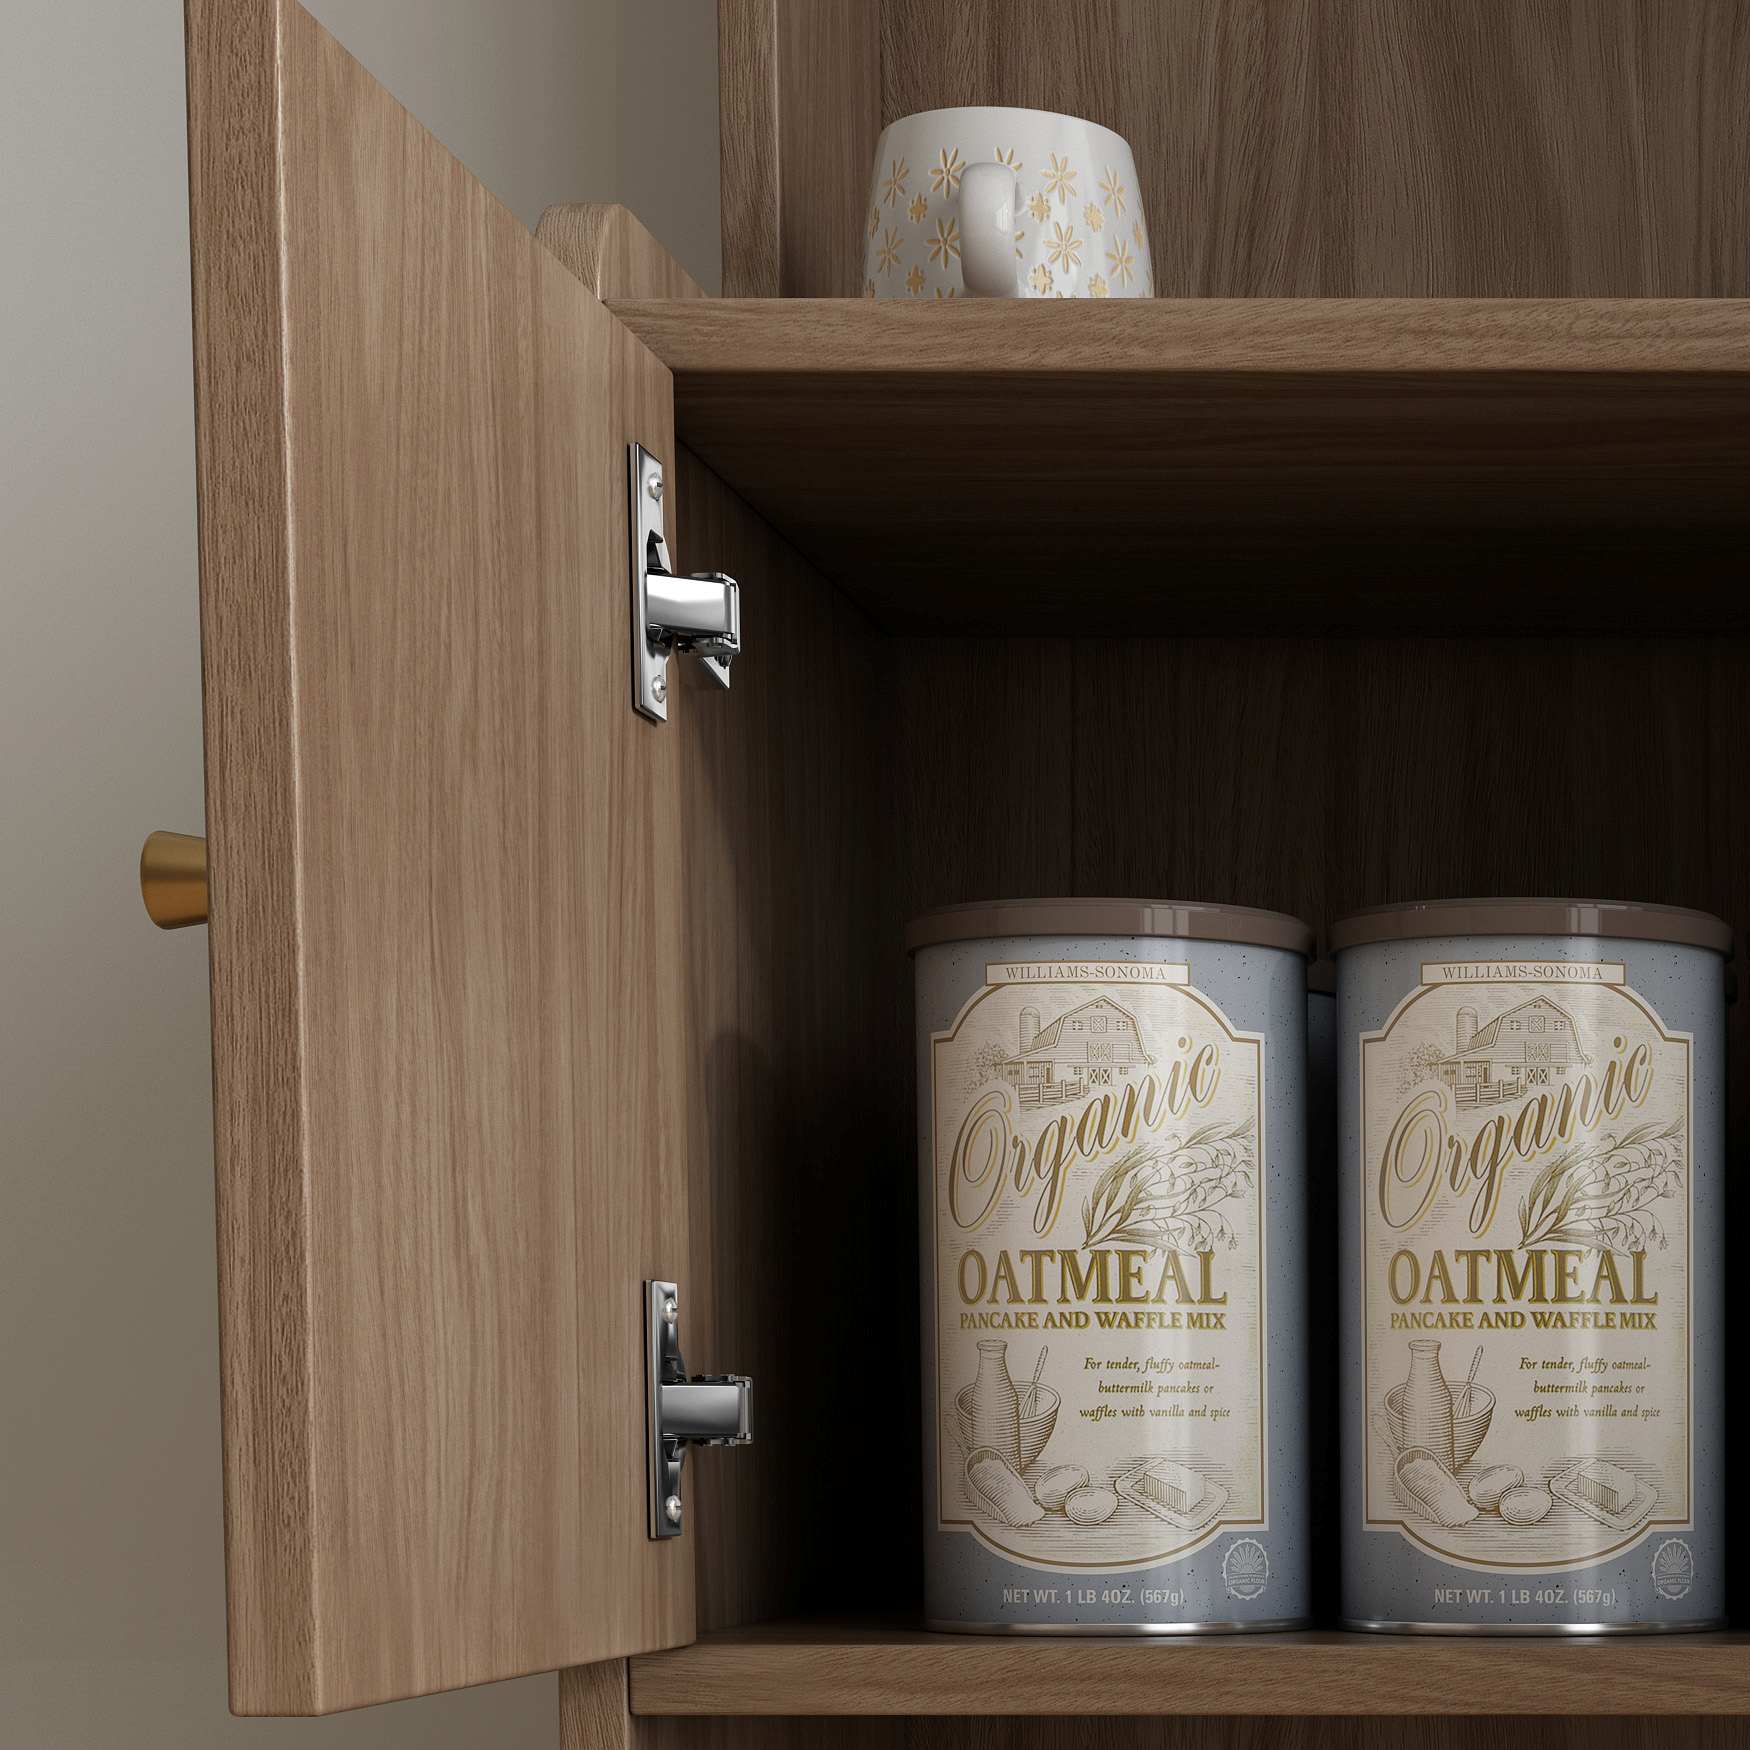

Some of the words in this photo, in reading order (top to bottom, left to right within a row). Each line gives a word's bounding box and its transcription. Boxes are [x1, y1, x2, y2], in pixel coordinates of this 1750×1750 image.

[1005, 965, 1168, 981] WILLIAMS-SONOMA
[1442, 965, 1604, 981] WILLIAMS-SONOMA
[949, 1036, 1221, 1239] Organic
[1378, 1036, 1654, 1239] Organic
[957, 1247, 1229, 1306] OATMEAL
[1387, 1247, 1659, 1306] OATMEAL
[959, 1310, 1039, 1331] PANCAKE
[1042, 1310, 1091, 1331] AND
[1094, 1310, 1183, 1331] WAFFLE
[1186, 1310, 1227, 1331] MIX
[1390, 1310, 1474, 1331] PANCAKE
[1477, 1310, 1527, 1331] AND
[1530, 1310, 1617, 1331] WAFFLE
[1619, 1310, 1658, 1331] MIX
[1083, 1356, 1103, 1371] For
[1106, 1356, 1140, 1374] tender,
[1142, 1356, 1175, 1375] fluffy
[1178, 1356, 1221, 1371] oatmeal-
[1519, 1356, 1538, 1371] For
[1541, 1356, 1575, 1374] tender,
[1577, 1356, 1609, 1375] fluffy
[1611, 1356, 1651, 1371] oatmeal-
[1097, 1379, 1154, 1395] buttermilk
[1156, 1380, 1201, 1398] pancakes
[1203, 1384, 1215, 1395] or
[1533, 1379, 1588, 1395] buttermilk
[1590, 1380, 1633, 1398] pancakes
[1635, 1384, 1646, 1395] or
[1079, 1403, 1118, 1422] waffles
[1120, 1403, 1146, 1418] with
[1149, 1403, 1185, 1418] vanilla
[1188, 1403, 1208, 1418] and
[1210, 1404, 1231, 1422] spice
[1514, 1403, 1553, 1422] waffles
[1555, 1403, 1580, 1418] with
[1583, 1403, 1618, 1418] vanilla
[1620, 1403, 1639, 1418] and
[1641, 1404, 1661, 1422] spice
[1003, 1589, 1031, 1605] NET
[1033, 1589, 1061, 1605] WT.
[1065, 1589, 1072, 1605] 1
[1078, 1589, 1097, 1605] LB
[1140, 1588, 1185, 1607] (567g)
[1434, 1589, 1463, 1605] NET
[1466, 1589, 1494, 1605] WT.
[1498, 1589, 1506, 1605] 1
[1510, 1589, 1531, 1605] LB
[1573, 1588, 1616, 1607] (567g)
